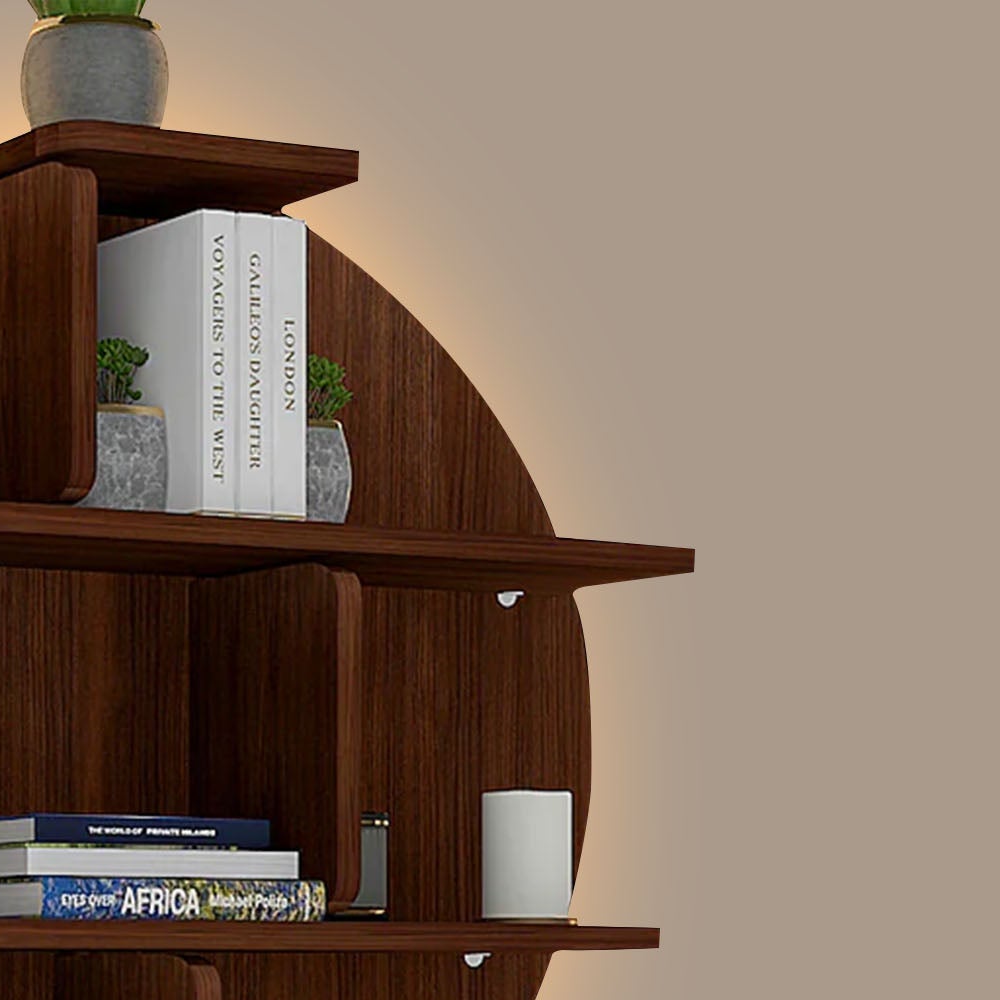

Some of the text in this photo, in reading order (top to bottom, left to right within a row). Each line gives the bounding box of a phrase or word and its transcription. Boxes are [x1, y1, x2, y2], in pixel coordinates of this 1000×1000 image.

[212, 235, 224, 484] VOYAGERS TO THE WEST
[284, 320, 295, 411] LONDON
[249, 360, 261, 469] DAUGHTER
[88, 826, 102, 835] THE
[103, 827, 131, 836] WORLD
[145, 827, 180, 836] PRIVATE
[61, 894, 86, 908] EYES
[88, 894, 116, 907] OVER
[120, 887, 200, 917] AFRICA
